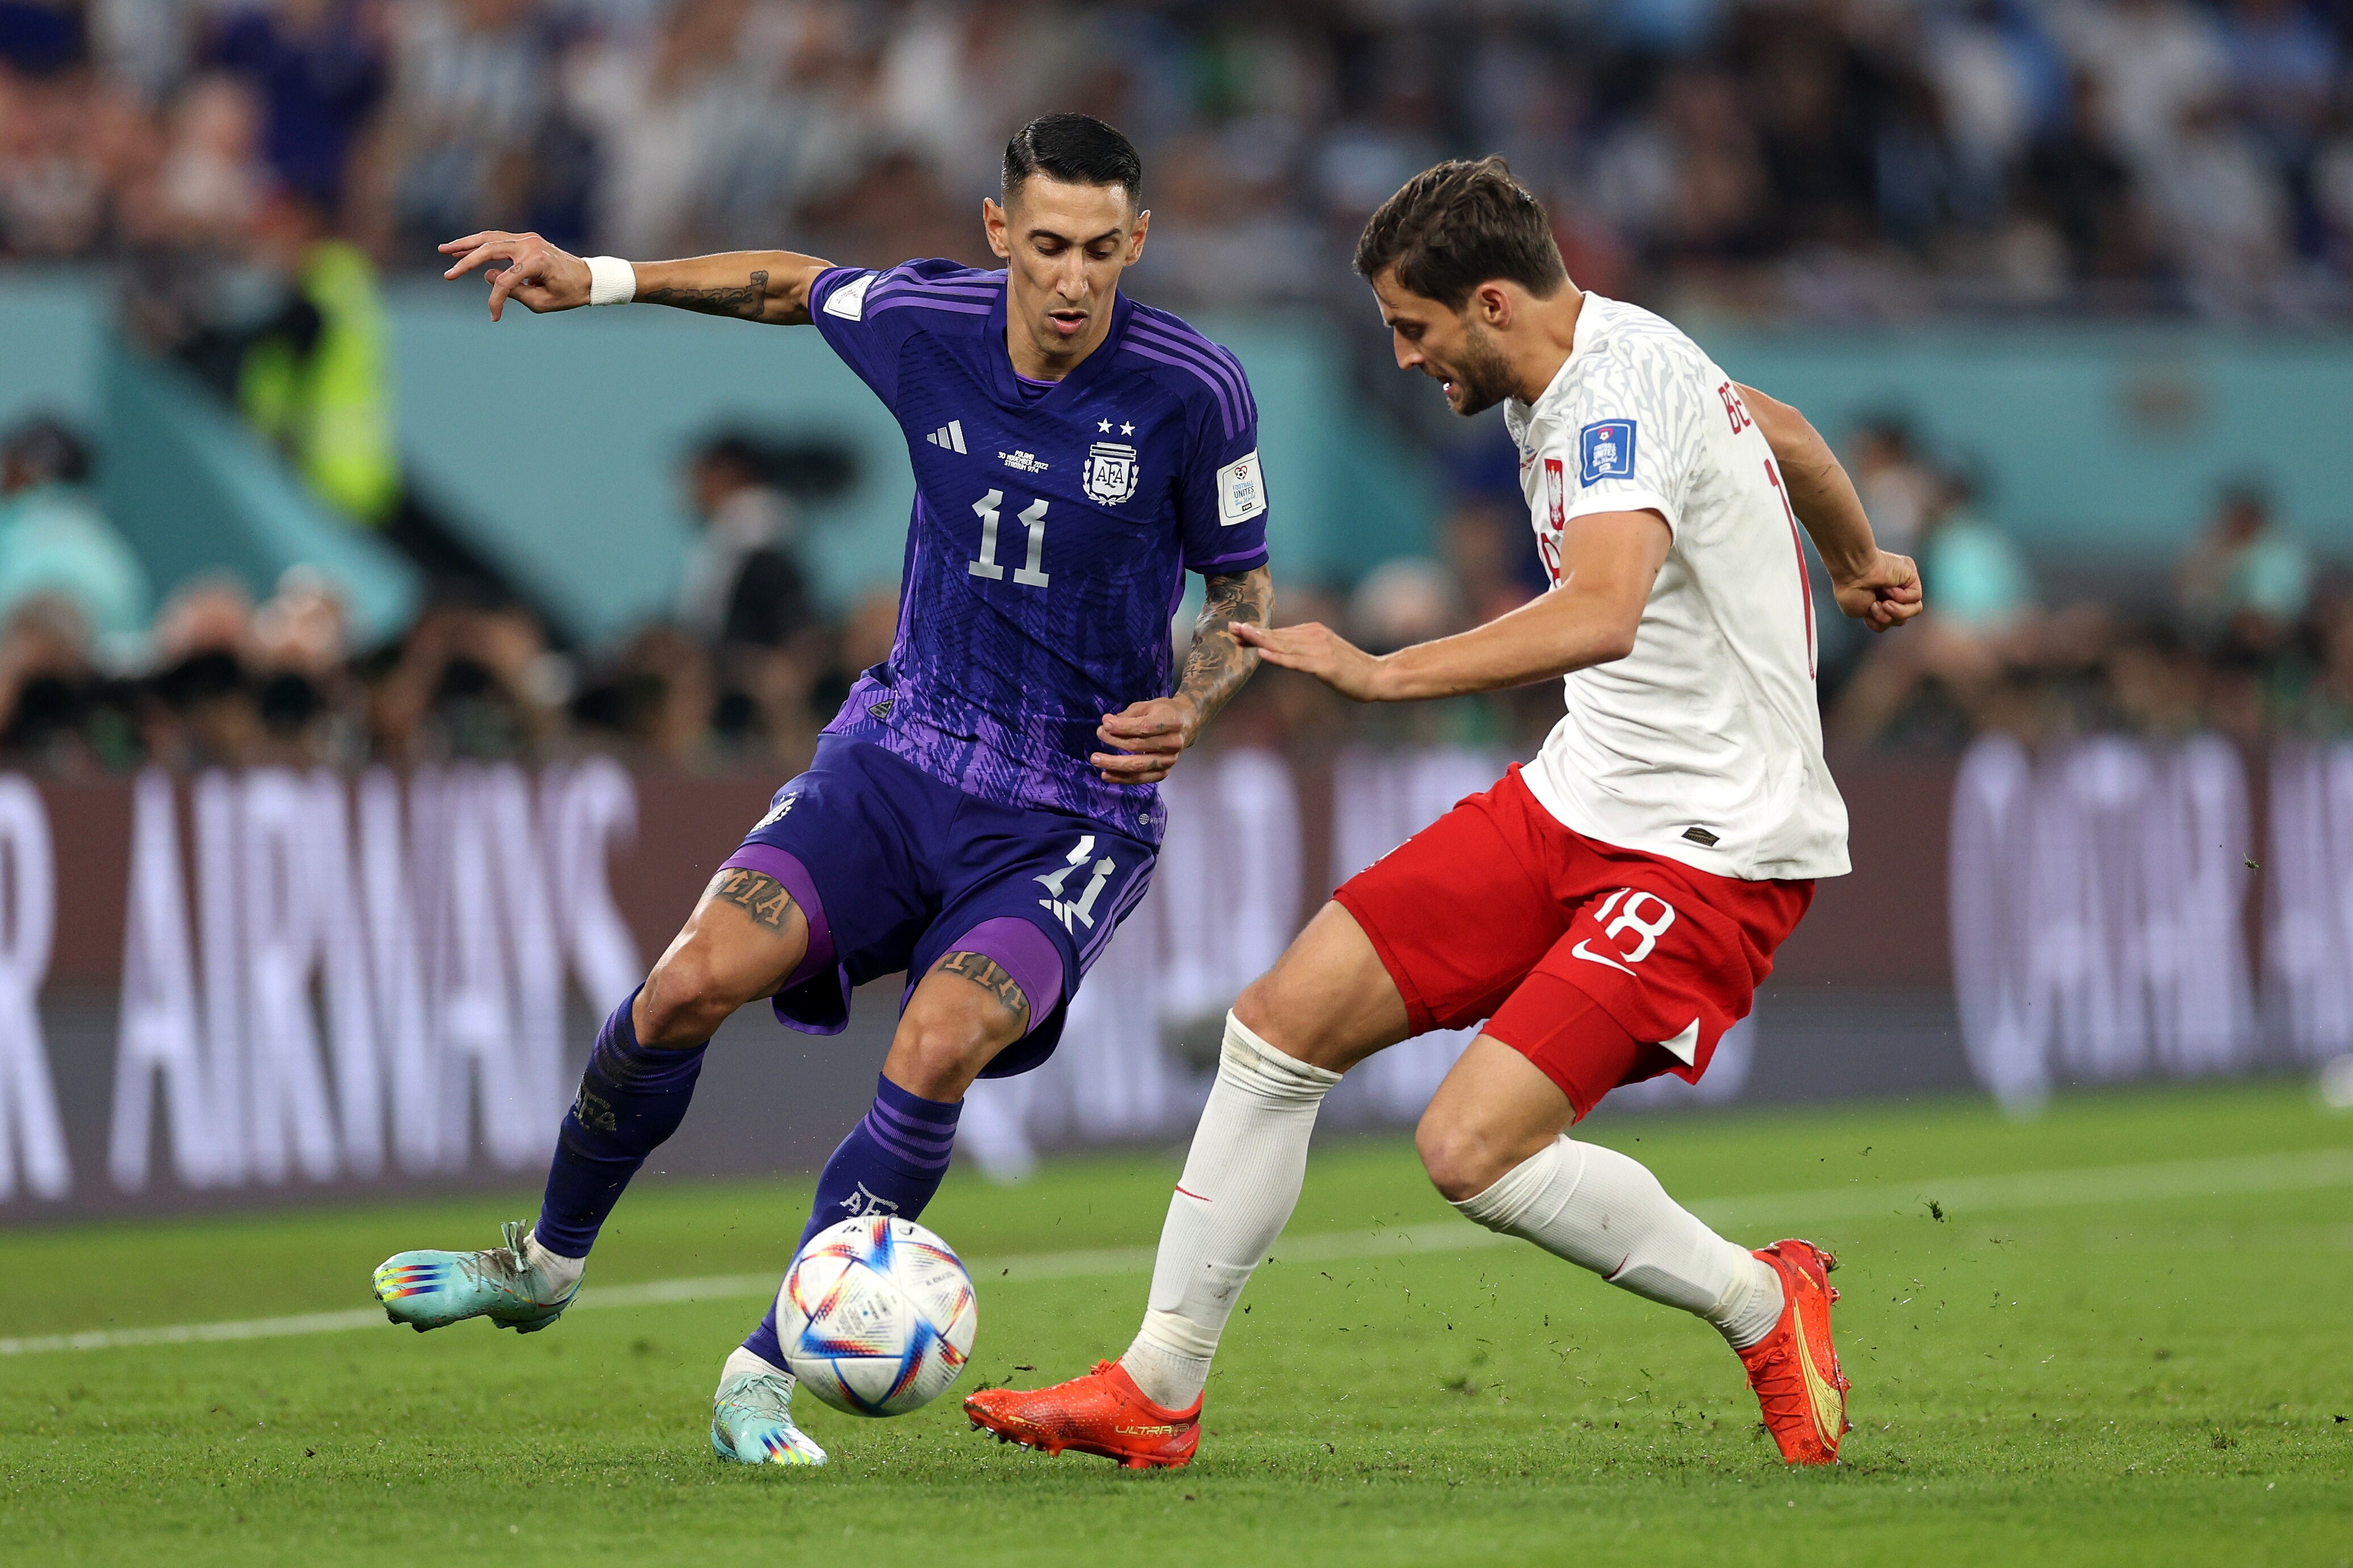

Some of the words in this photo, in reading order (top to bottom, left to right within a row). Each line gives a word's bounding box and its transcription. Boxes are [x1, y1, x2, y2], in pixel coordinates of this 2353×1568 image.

[1006, 454, 1032, 466] NOVEMBER
[1034, 461, 1049, 470] 2022
[1014, 450, 1034, 460] POLAND
[1004, 460, 1026, 470] STADIUM
[1095, 459, 1125, 489] AFA
[1232, 480, 1254, 491] FOOTBALL
[1234, 486, 1255, 499] UNITES
[968, 488, 1050, 588] 11
[1032, 835, 1116, 930] 11
[1593, 887, 1676, 963] 18
[107, 755, 658, 1195] AIRWAYS
[1114, 1424, 1174, 1437] ULTRA
